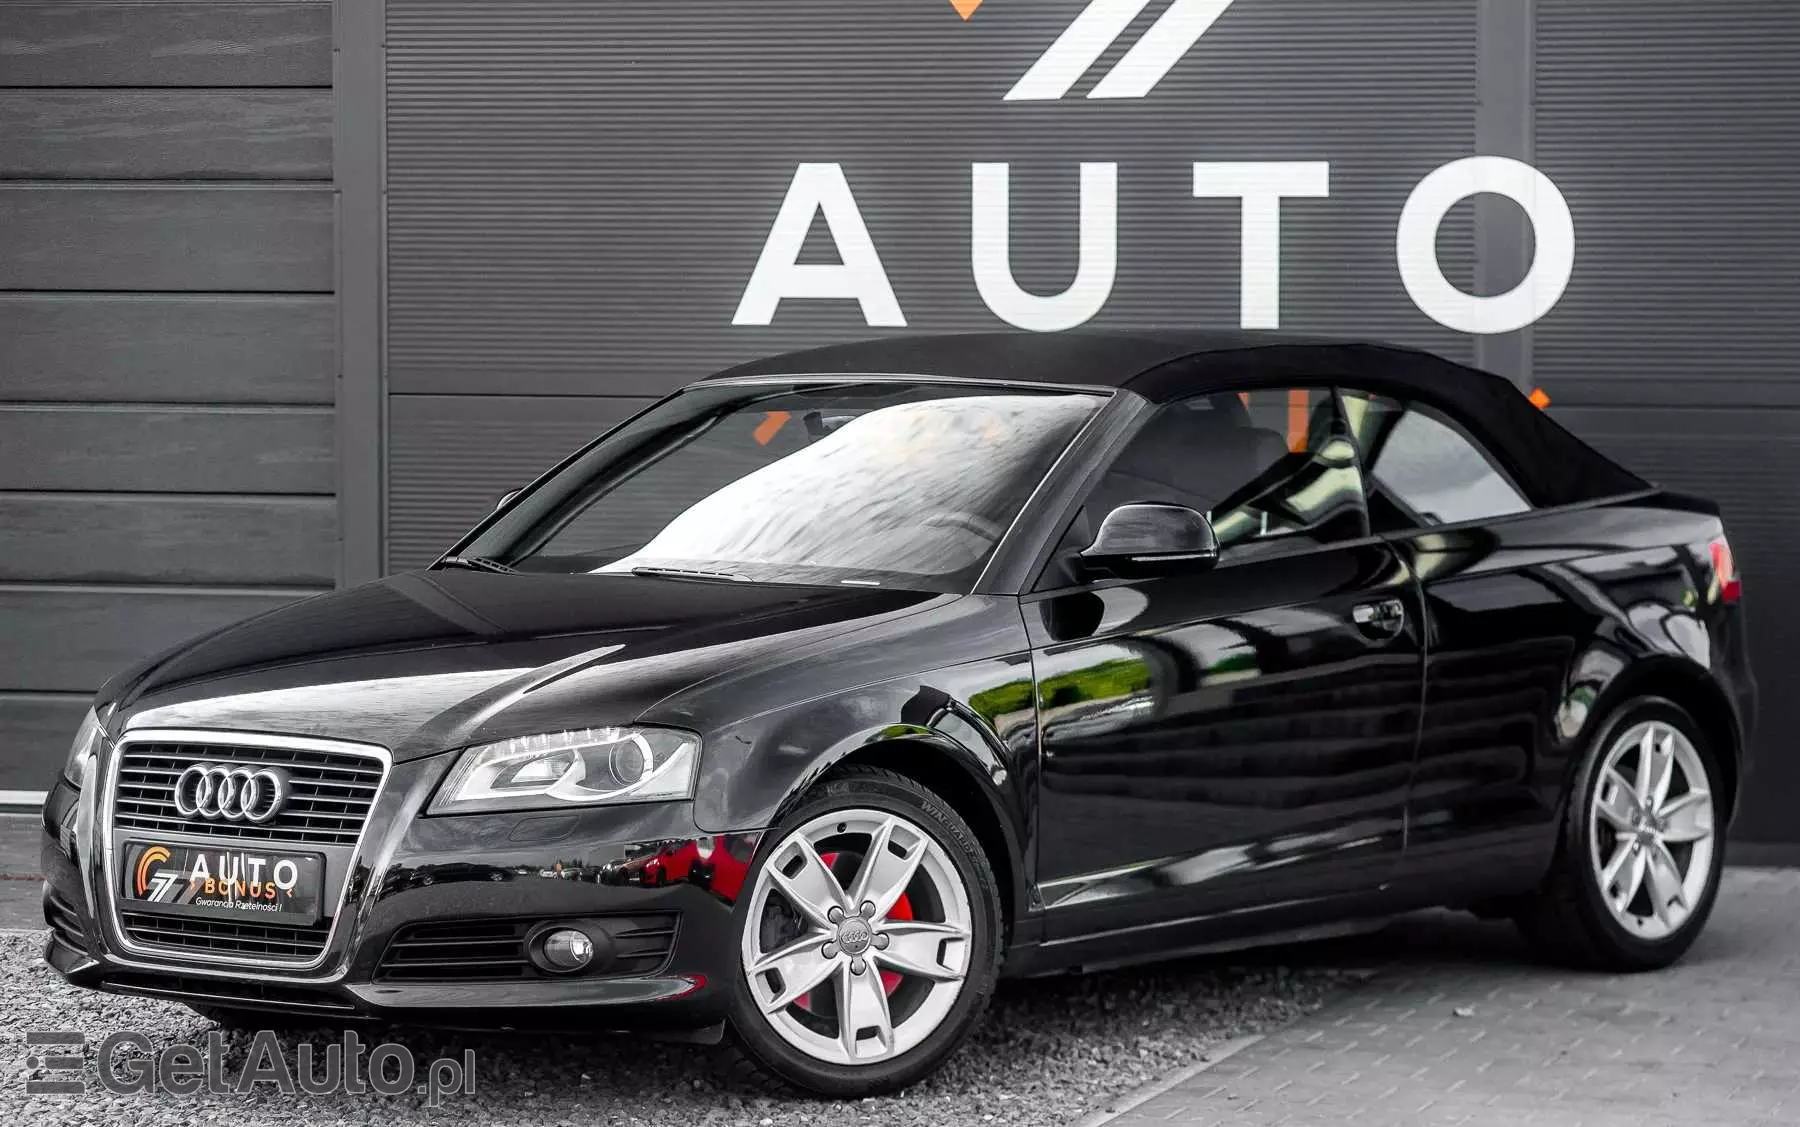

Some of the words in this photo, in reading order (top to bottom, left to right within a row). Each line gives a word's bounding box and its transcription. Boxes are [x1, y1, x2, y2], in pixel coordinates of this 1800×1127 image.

[732, 156, 1575, 333] AUTO
[189, 853, 298, 890] AUTO
[204, 877, 276, 899] BONUS
